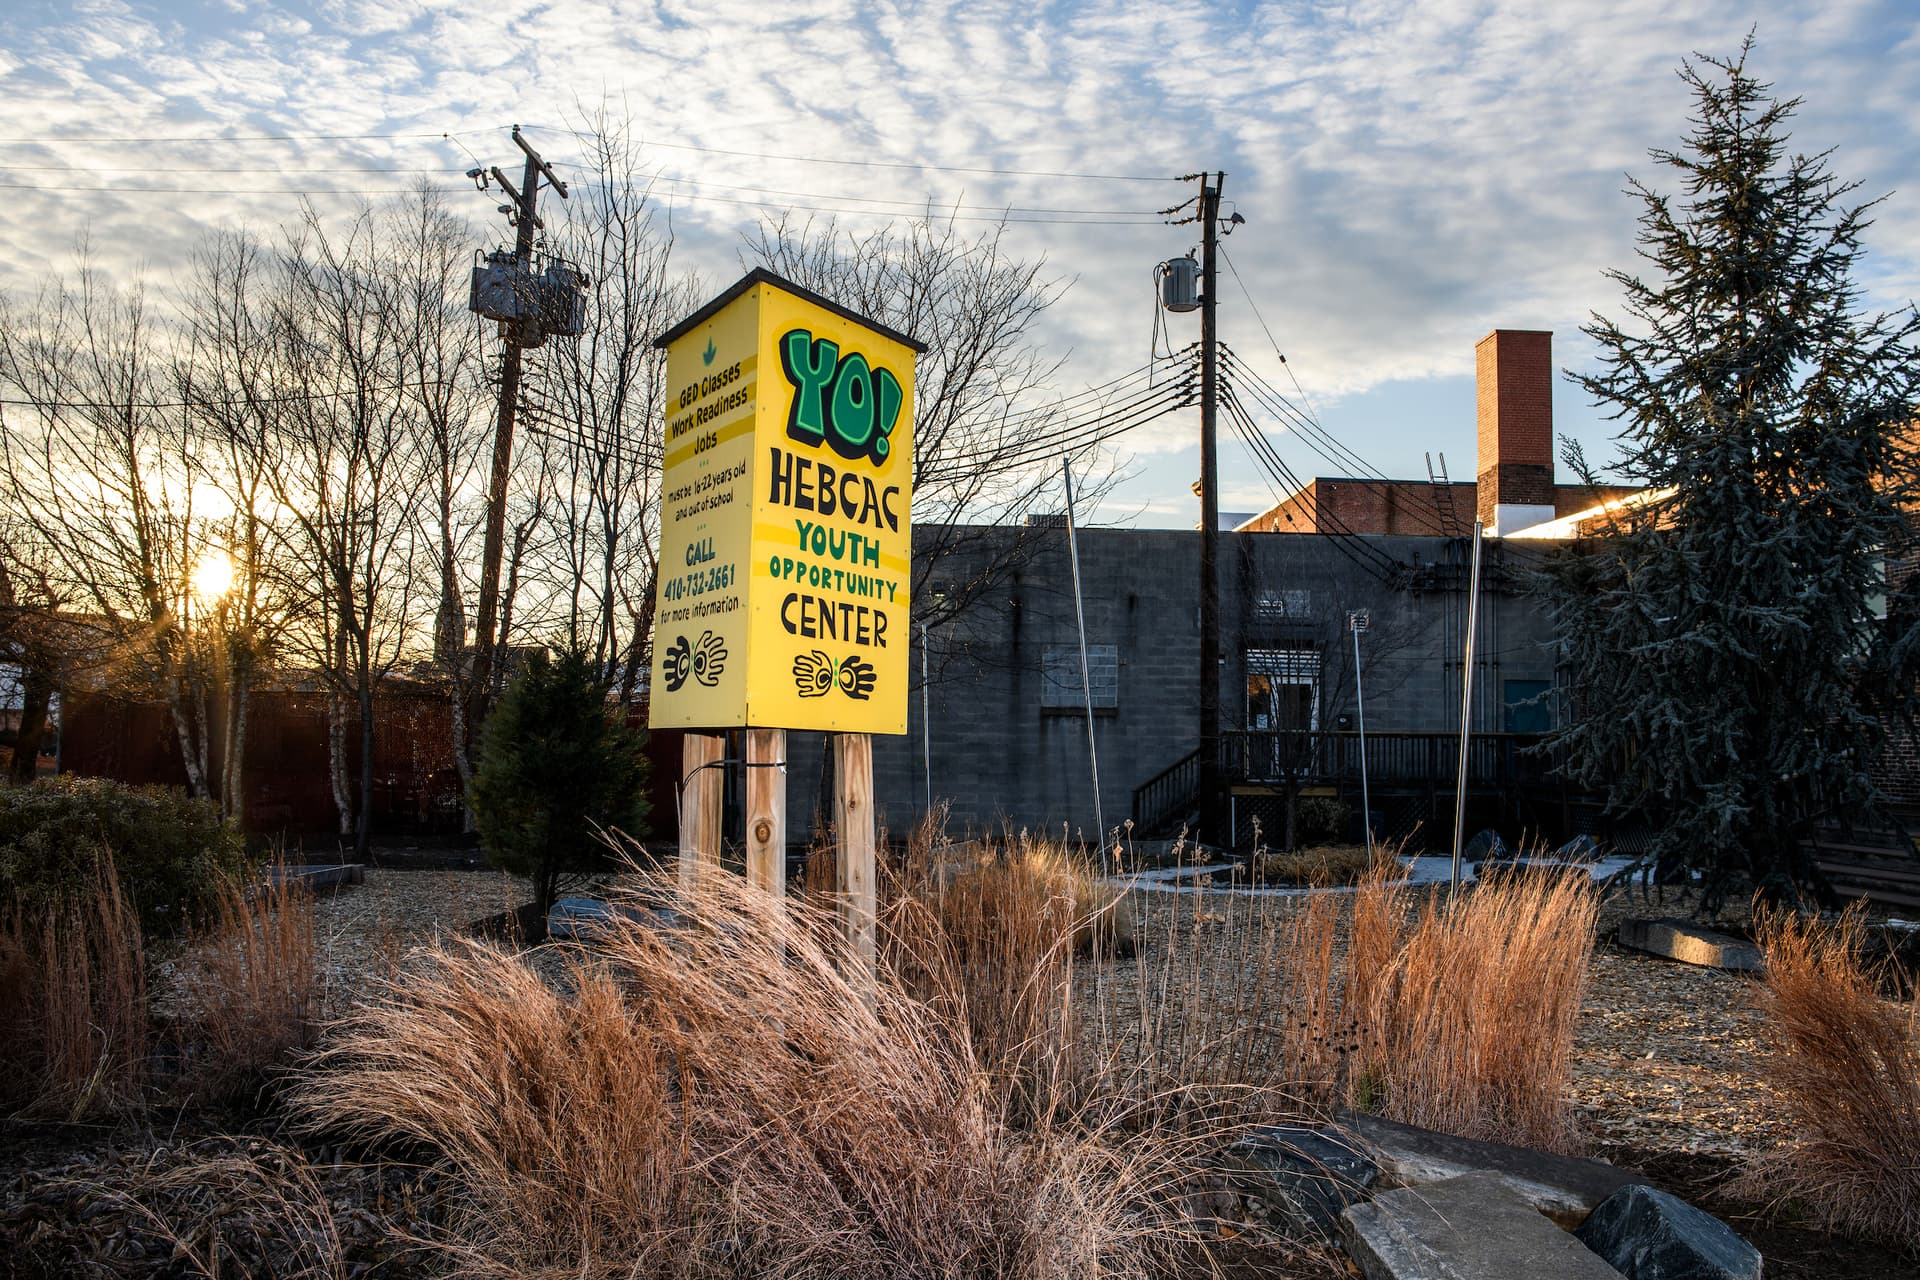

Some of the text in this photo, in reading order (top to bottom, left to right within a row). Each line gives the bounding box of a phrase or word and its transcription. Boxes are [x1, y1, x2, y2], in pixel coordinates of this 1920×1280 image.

[680, 362, 741, 409] GED Classes
[779, 328, 903, 467] YO!
[672, 386, 748, 439] Work Readiness
[694, 431, 718, 455] Jobs
[668, 456, 746, 504] must be 16-22 years old
[675, 486, 734, 522] and out of school
[769, 446, 900, 533] HEBCAC
[686, 536, 716, 567] CALL
[795, 518, 880, 569] YOUTH
[664, 563, 735, 602] 410-732-2661
[769, 555, 898, 603] OPPORTUNITY
[661, 595, 739, 625] for more information
[780, 592, 888, 648] CENTER
